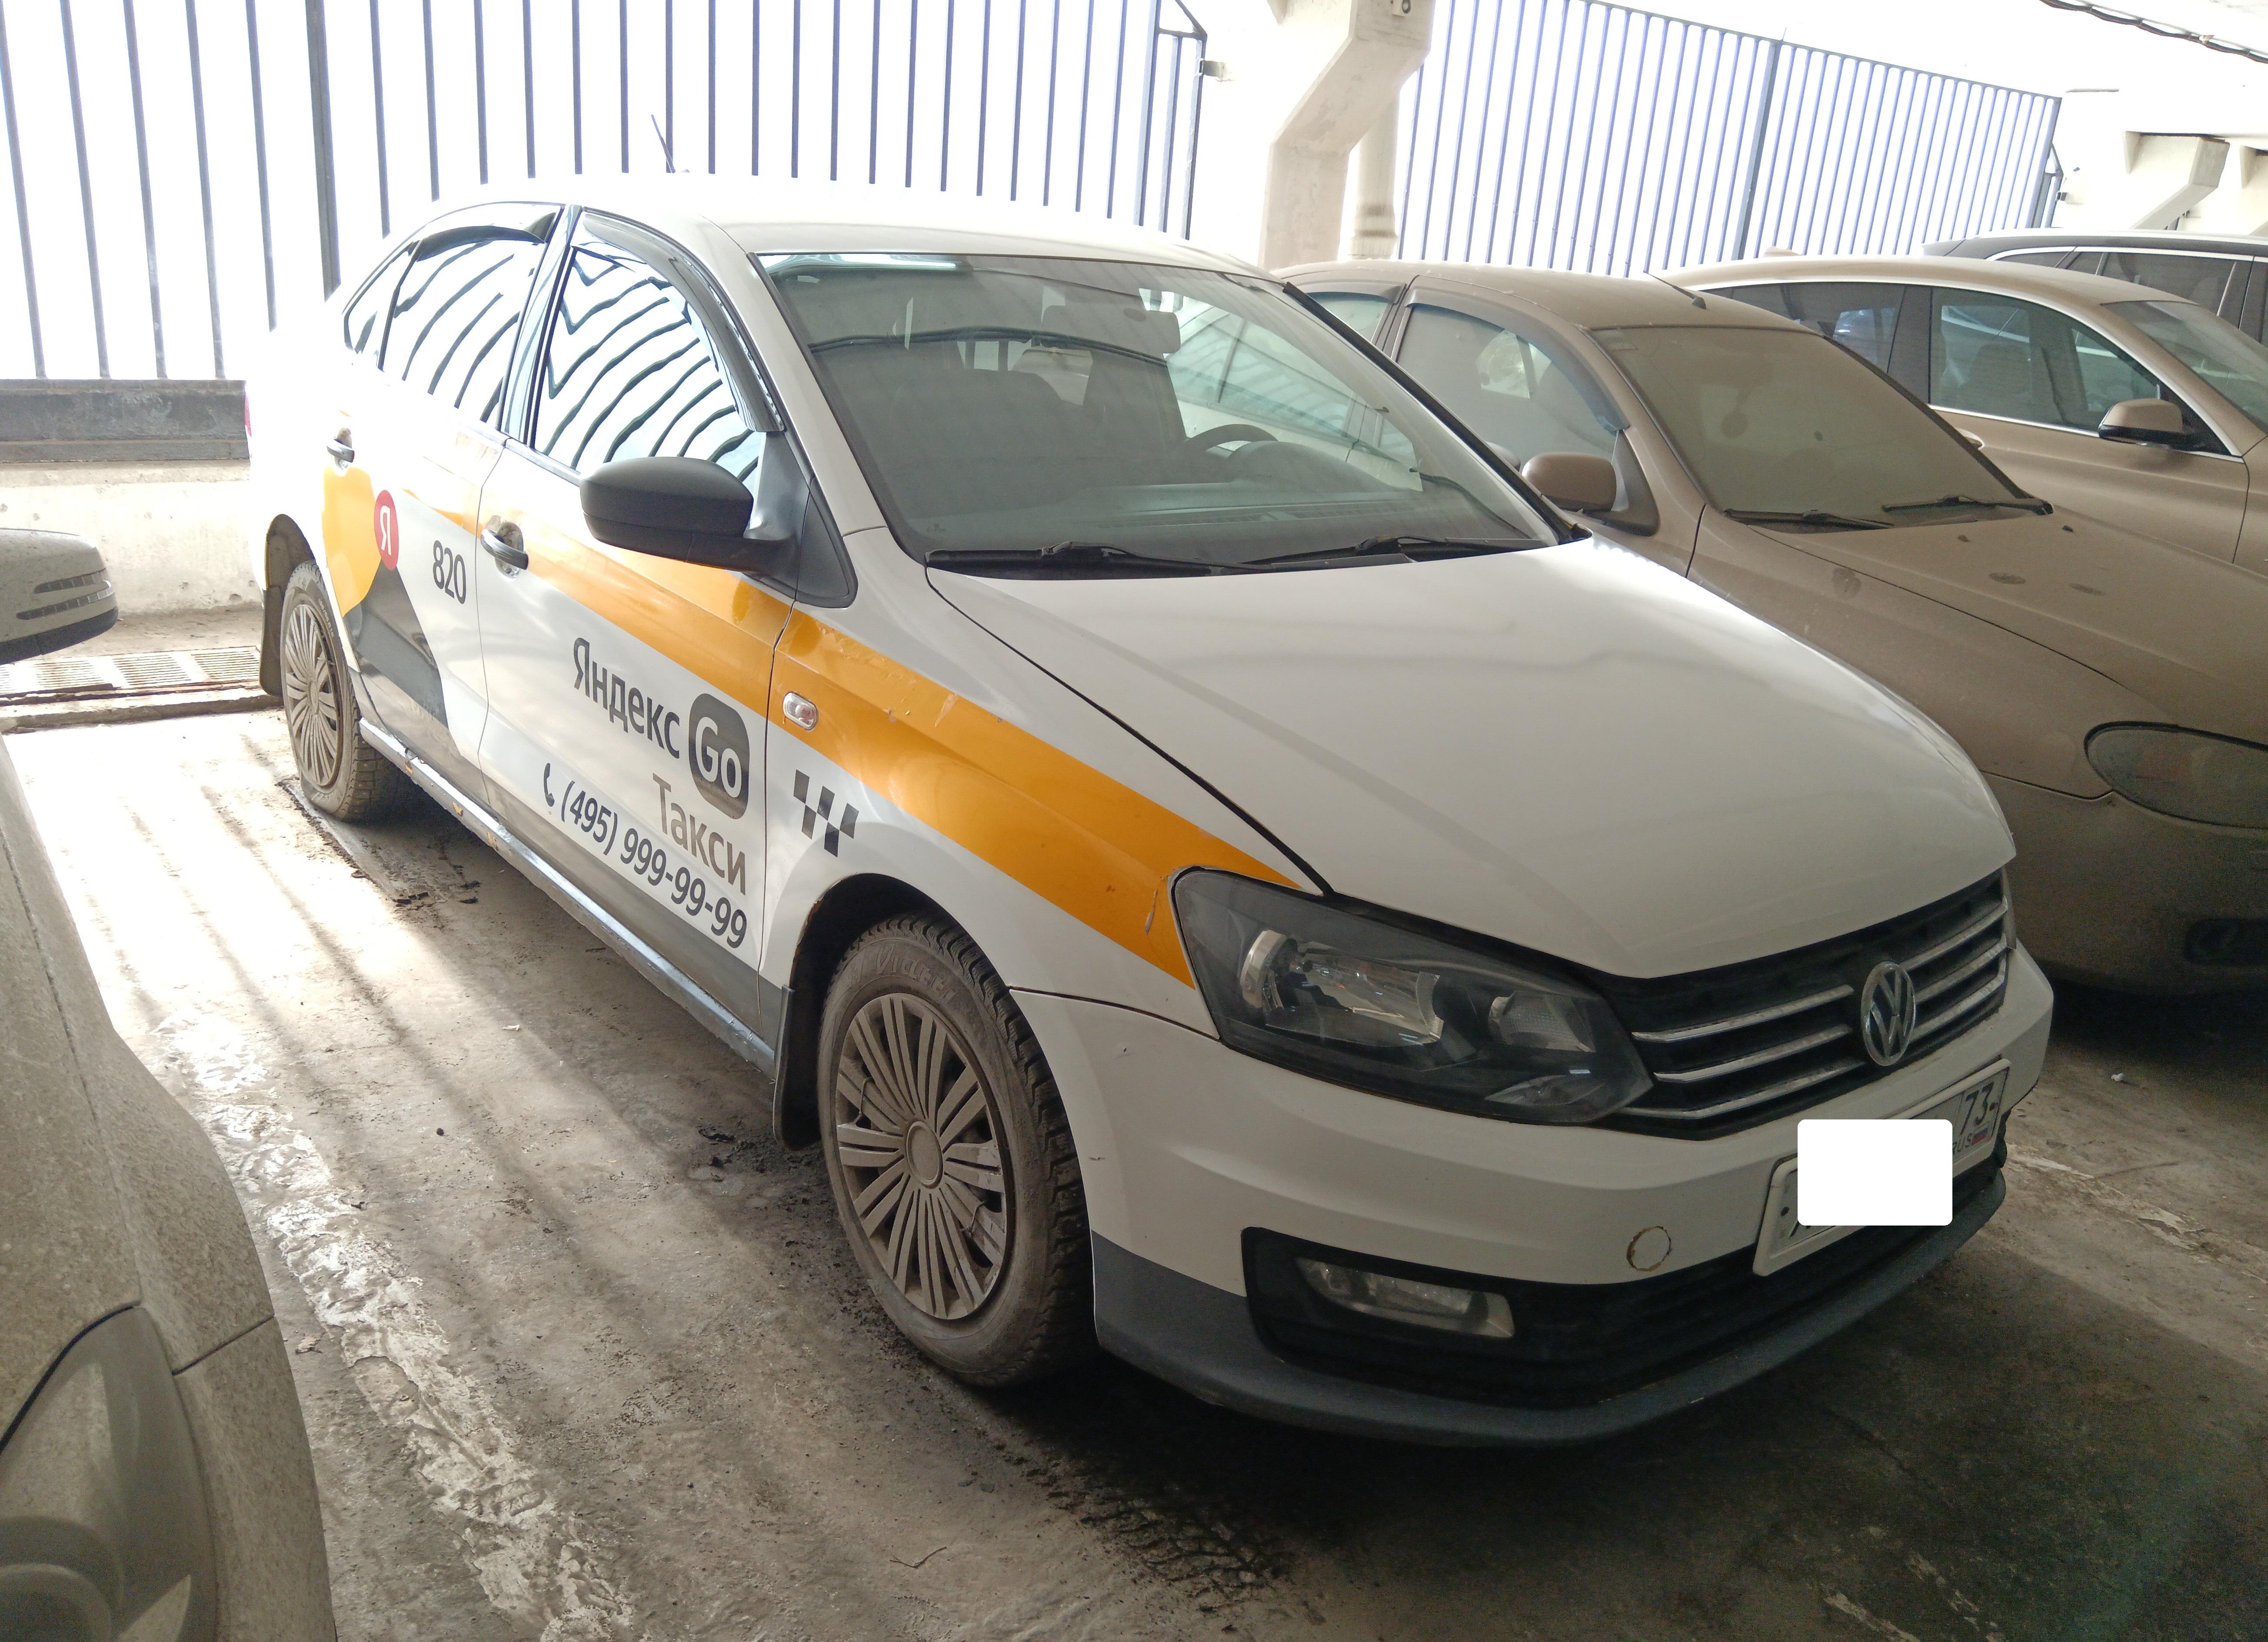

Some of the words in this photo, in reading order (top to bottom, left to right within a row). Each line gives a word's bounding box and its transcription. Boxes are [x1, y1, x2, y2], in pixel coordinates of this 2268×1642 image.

[380, 505, 392, 556] Я
[433, 540, 466, 604] 820
[573, 637, 680, 759] Яндекс
[696, 716, 742, 798] Go
[561, 780, 618, 856] (495)
[620, 828, 747, 949] 999-99-99
[653, 772, 746, 896] Такси
[1960, 1081, 1995, 1136] 73
